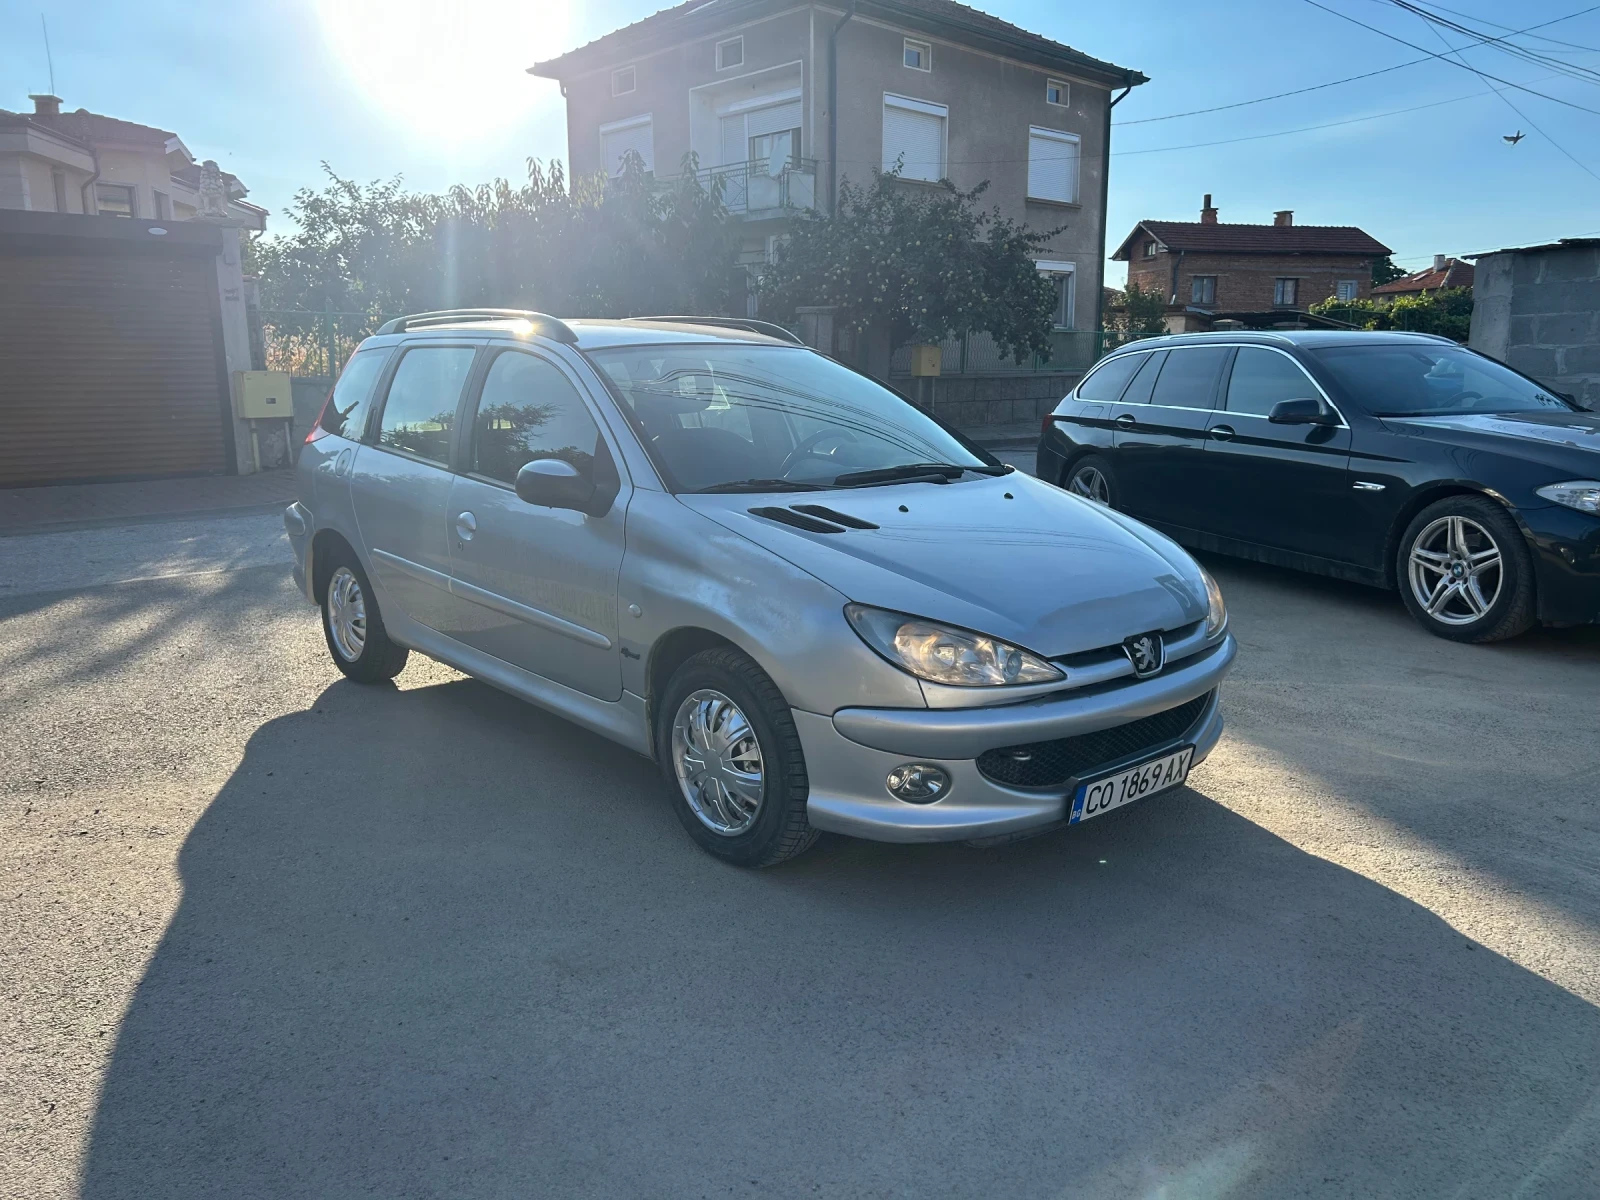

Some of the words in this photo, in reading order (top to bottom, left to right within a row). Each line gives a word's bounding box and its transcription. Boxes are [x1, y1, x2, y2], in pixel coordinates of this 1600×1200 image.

[1086, 781, 1114, 814] CO
[1119, 763, 1163, 803] 1869
[1162, 752, 1189, 786] AX
[1071, 809, 1082, 820] BG
